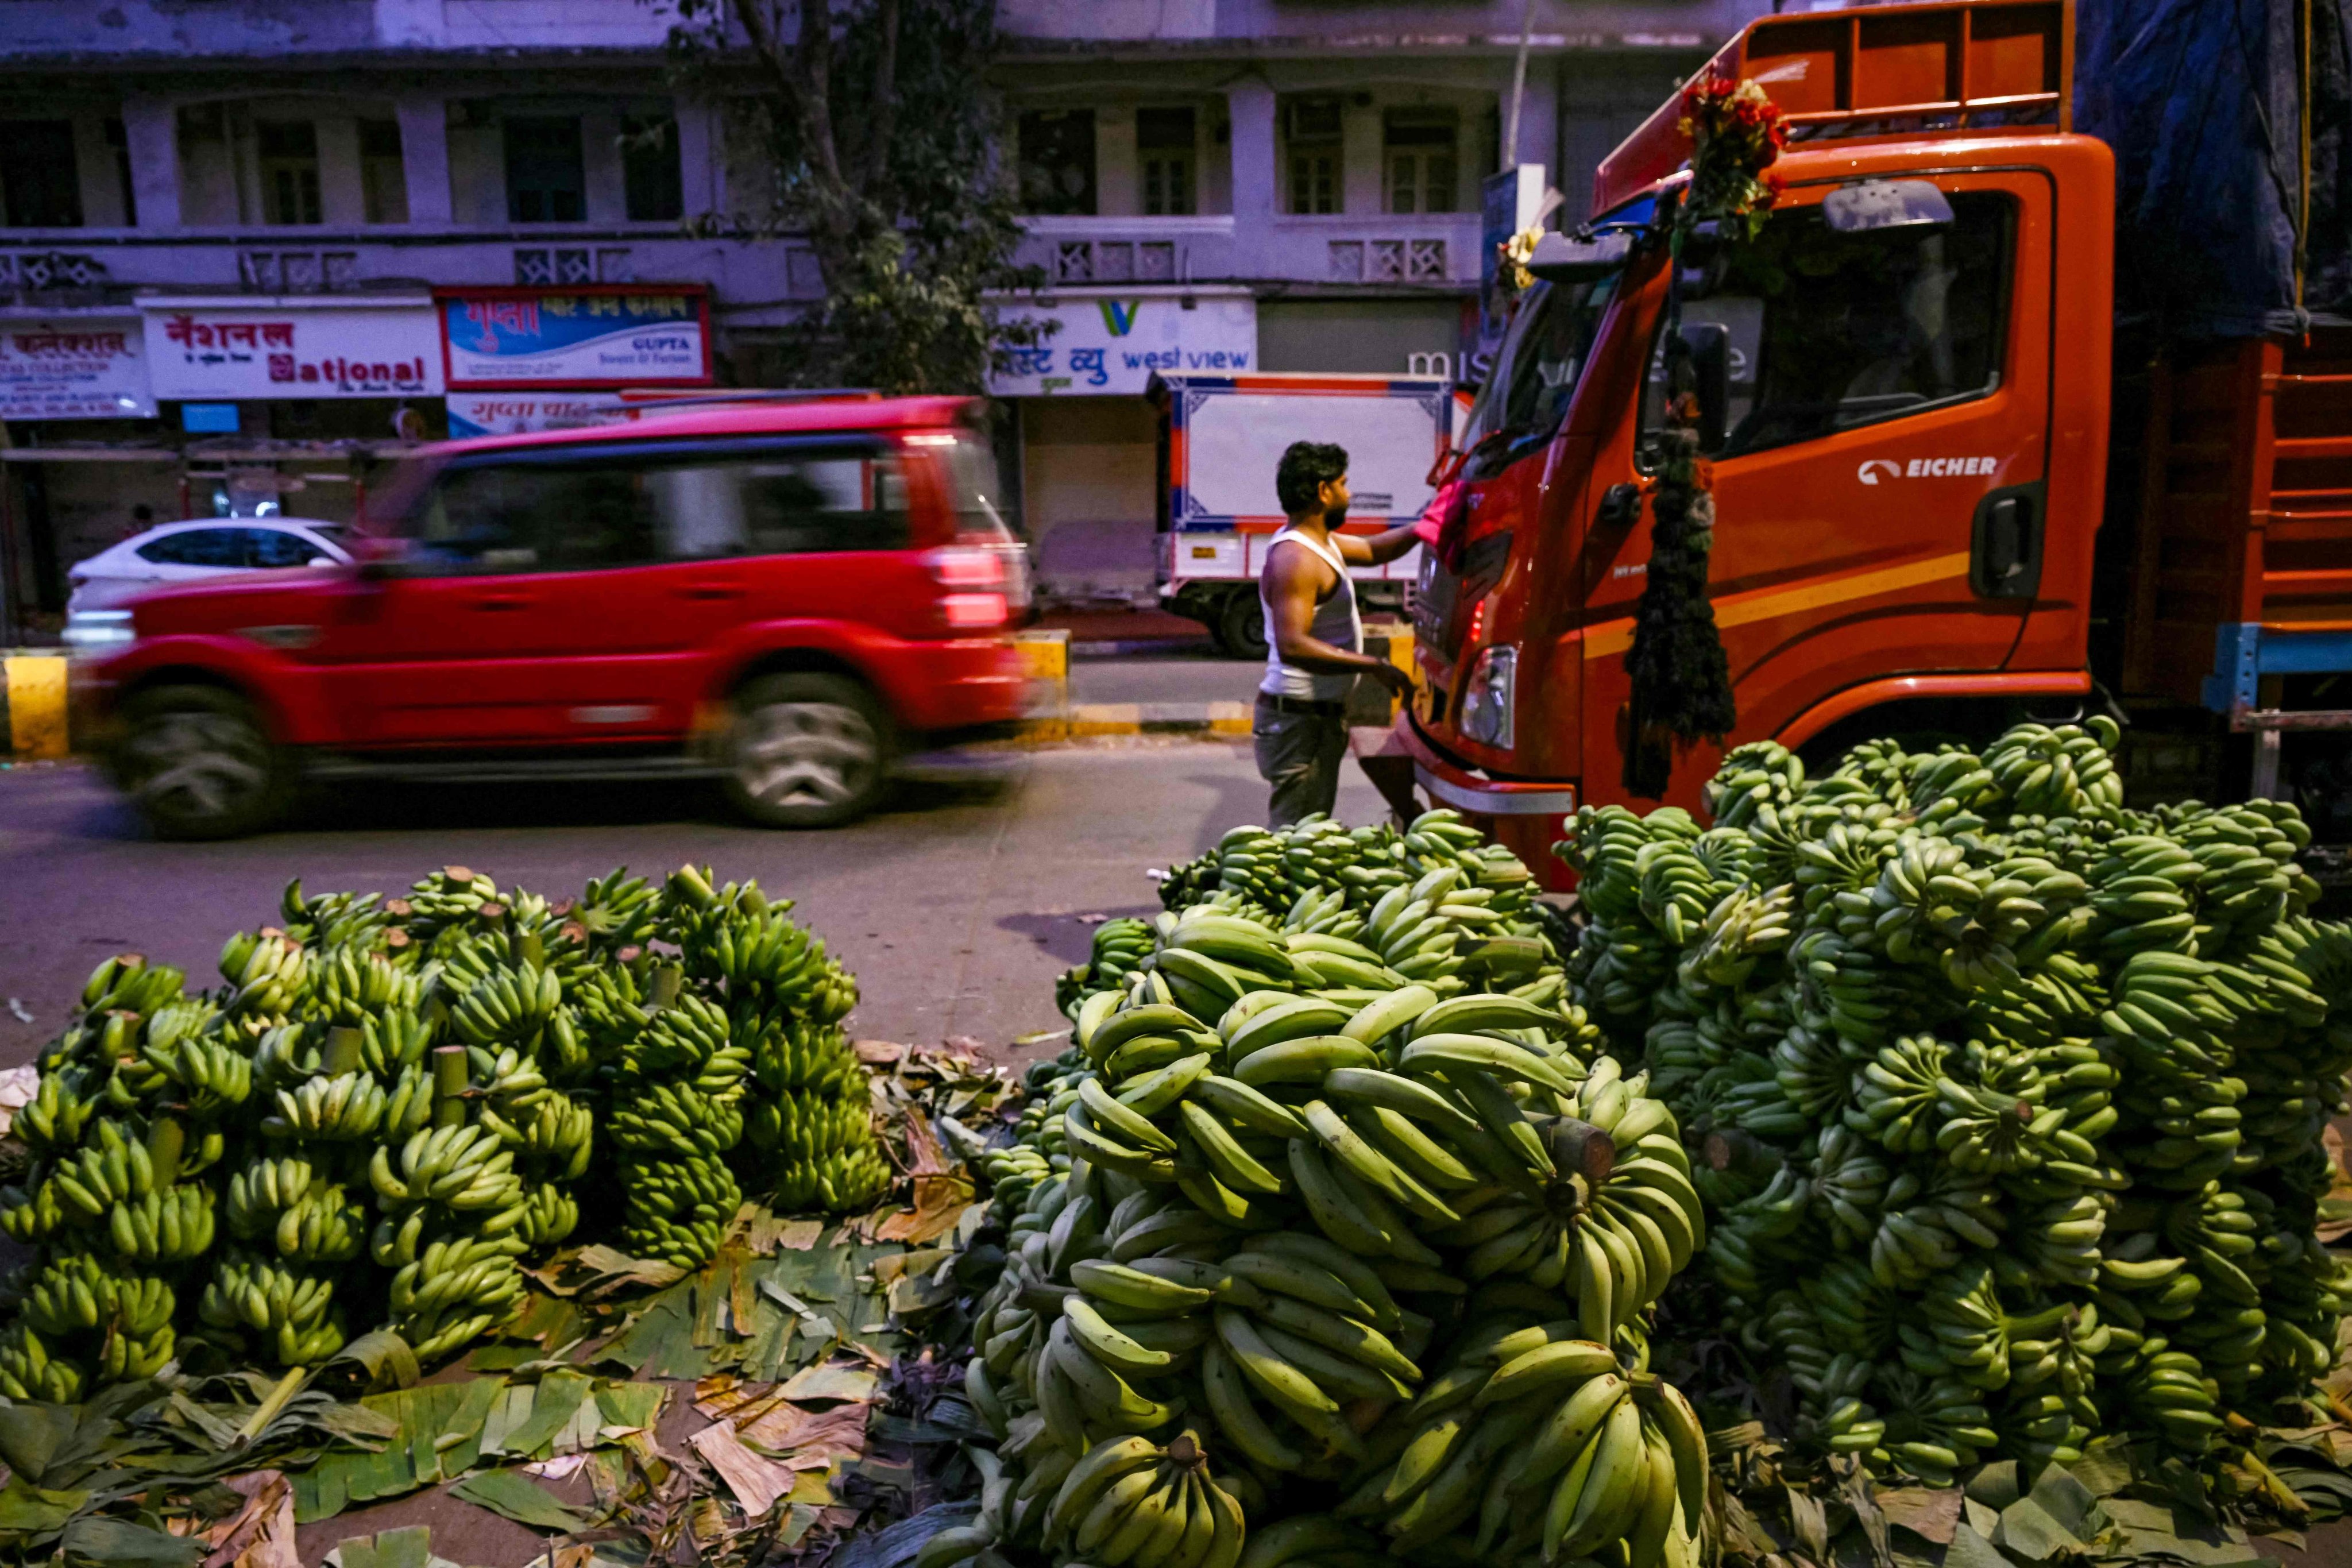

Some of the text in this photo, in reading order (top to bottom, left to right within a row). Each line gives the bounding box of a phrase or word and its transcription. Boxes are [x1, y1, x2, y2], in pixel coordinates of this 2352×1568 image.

[632, 337, 690, 351] GUPTA
[1188, 350, 1249, 369] view
[1906, 456, 1998, 478] EICHER
